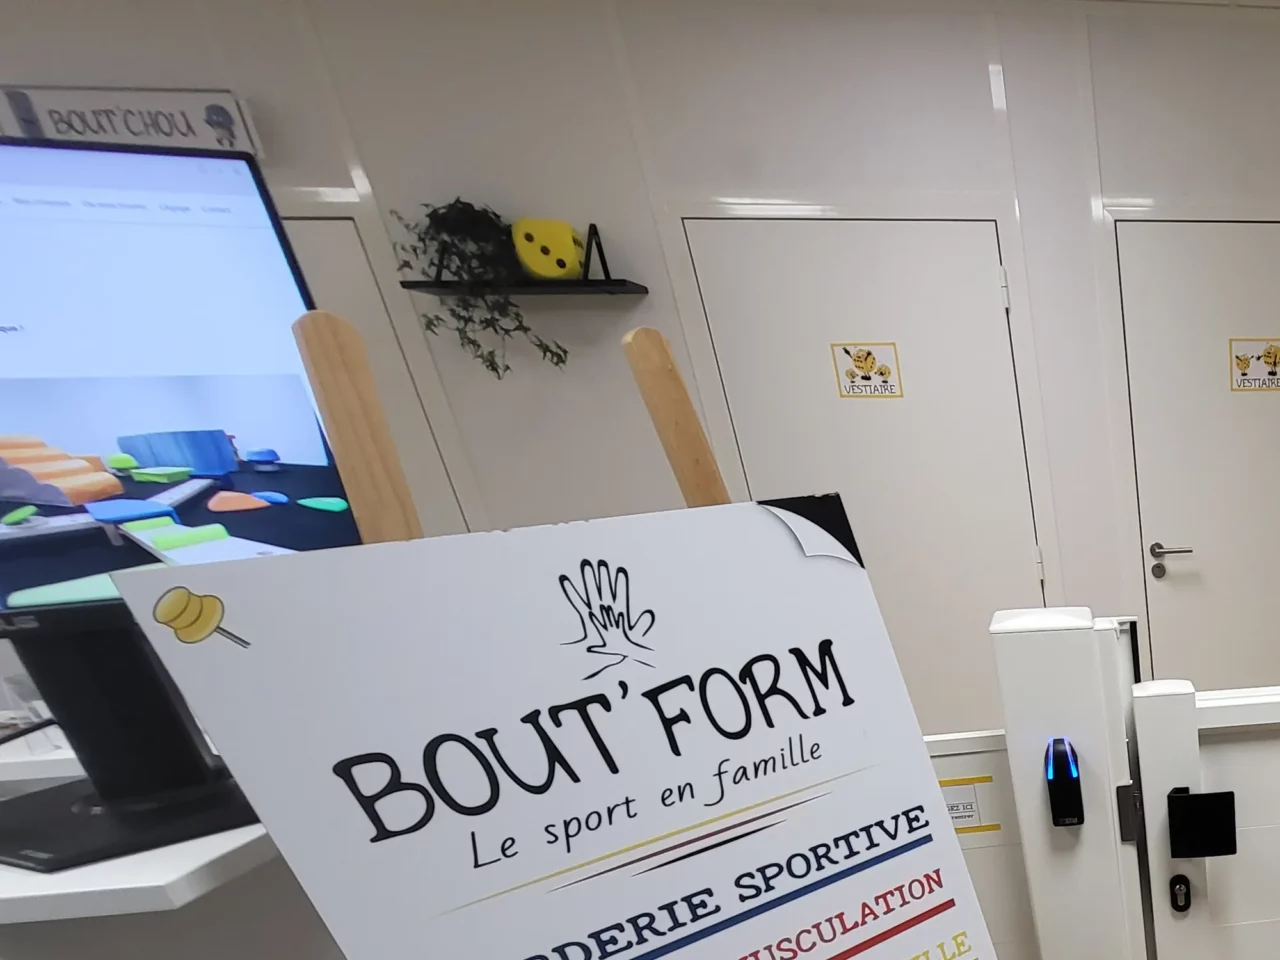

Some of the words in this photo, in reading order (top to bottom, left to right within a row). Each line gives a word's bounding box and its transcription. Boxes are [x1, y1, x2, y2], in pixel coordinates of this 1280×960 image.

[843, 384, 897, 395] VESTIAIRE
[332, 639, 855, 843] BOUT'FORM
[471, 830, 519, 869] Le
[544, 796, 638, 853] sport
[660, 779, 695, 808] en
[703, 735, 822, 807] famille
[735, 805, 930, 902] SPORTIVE
